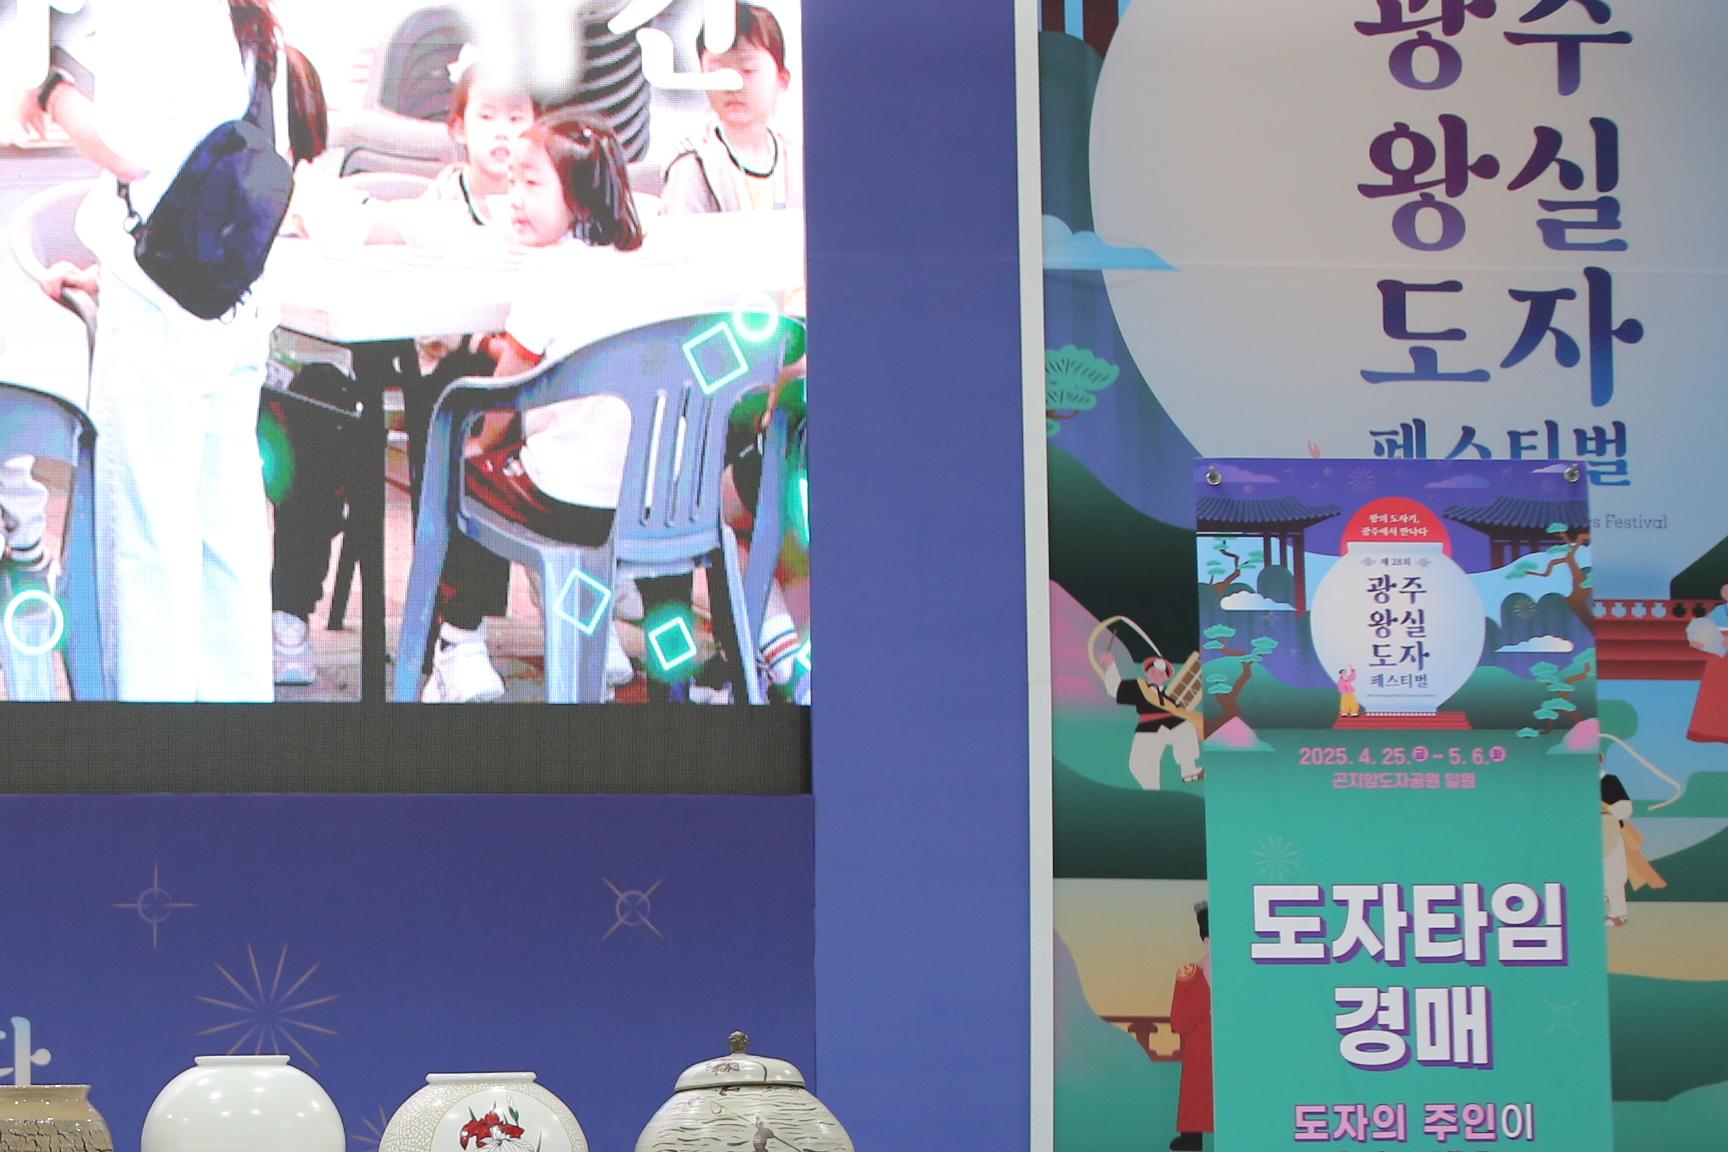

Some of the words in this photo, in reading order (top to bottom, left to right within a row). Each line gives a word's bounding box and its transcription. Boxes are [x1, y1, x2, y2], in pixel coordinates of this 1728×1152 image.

[1357, 113, 1629, 251] 왕실
[1359, 266, 1645, 407] 도자
[1605, 514, 1667, 529] Festival
[1366, 574, 1427, 604] 광주
[1368, 608, 1427, 639] 왕실
[1368, 640, 1431, 671] 도자
[1370, 673, 1428, 688] 페스티벌
[1299, 747, 1353, 765] 2025.
[1359, 747, 1376, 765] 4.
[1250, 882, 1568, 966] 도자타임
[1334, 986, 1493, 1070] 경매
[1294, 1104, 1407, 1142] 도자의
[1424, 1102, 1535, 1141] 주인이
